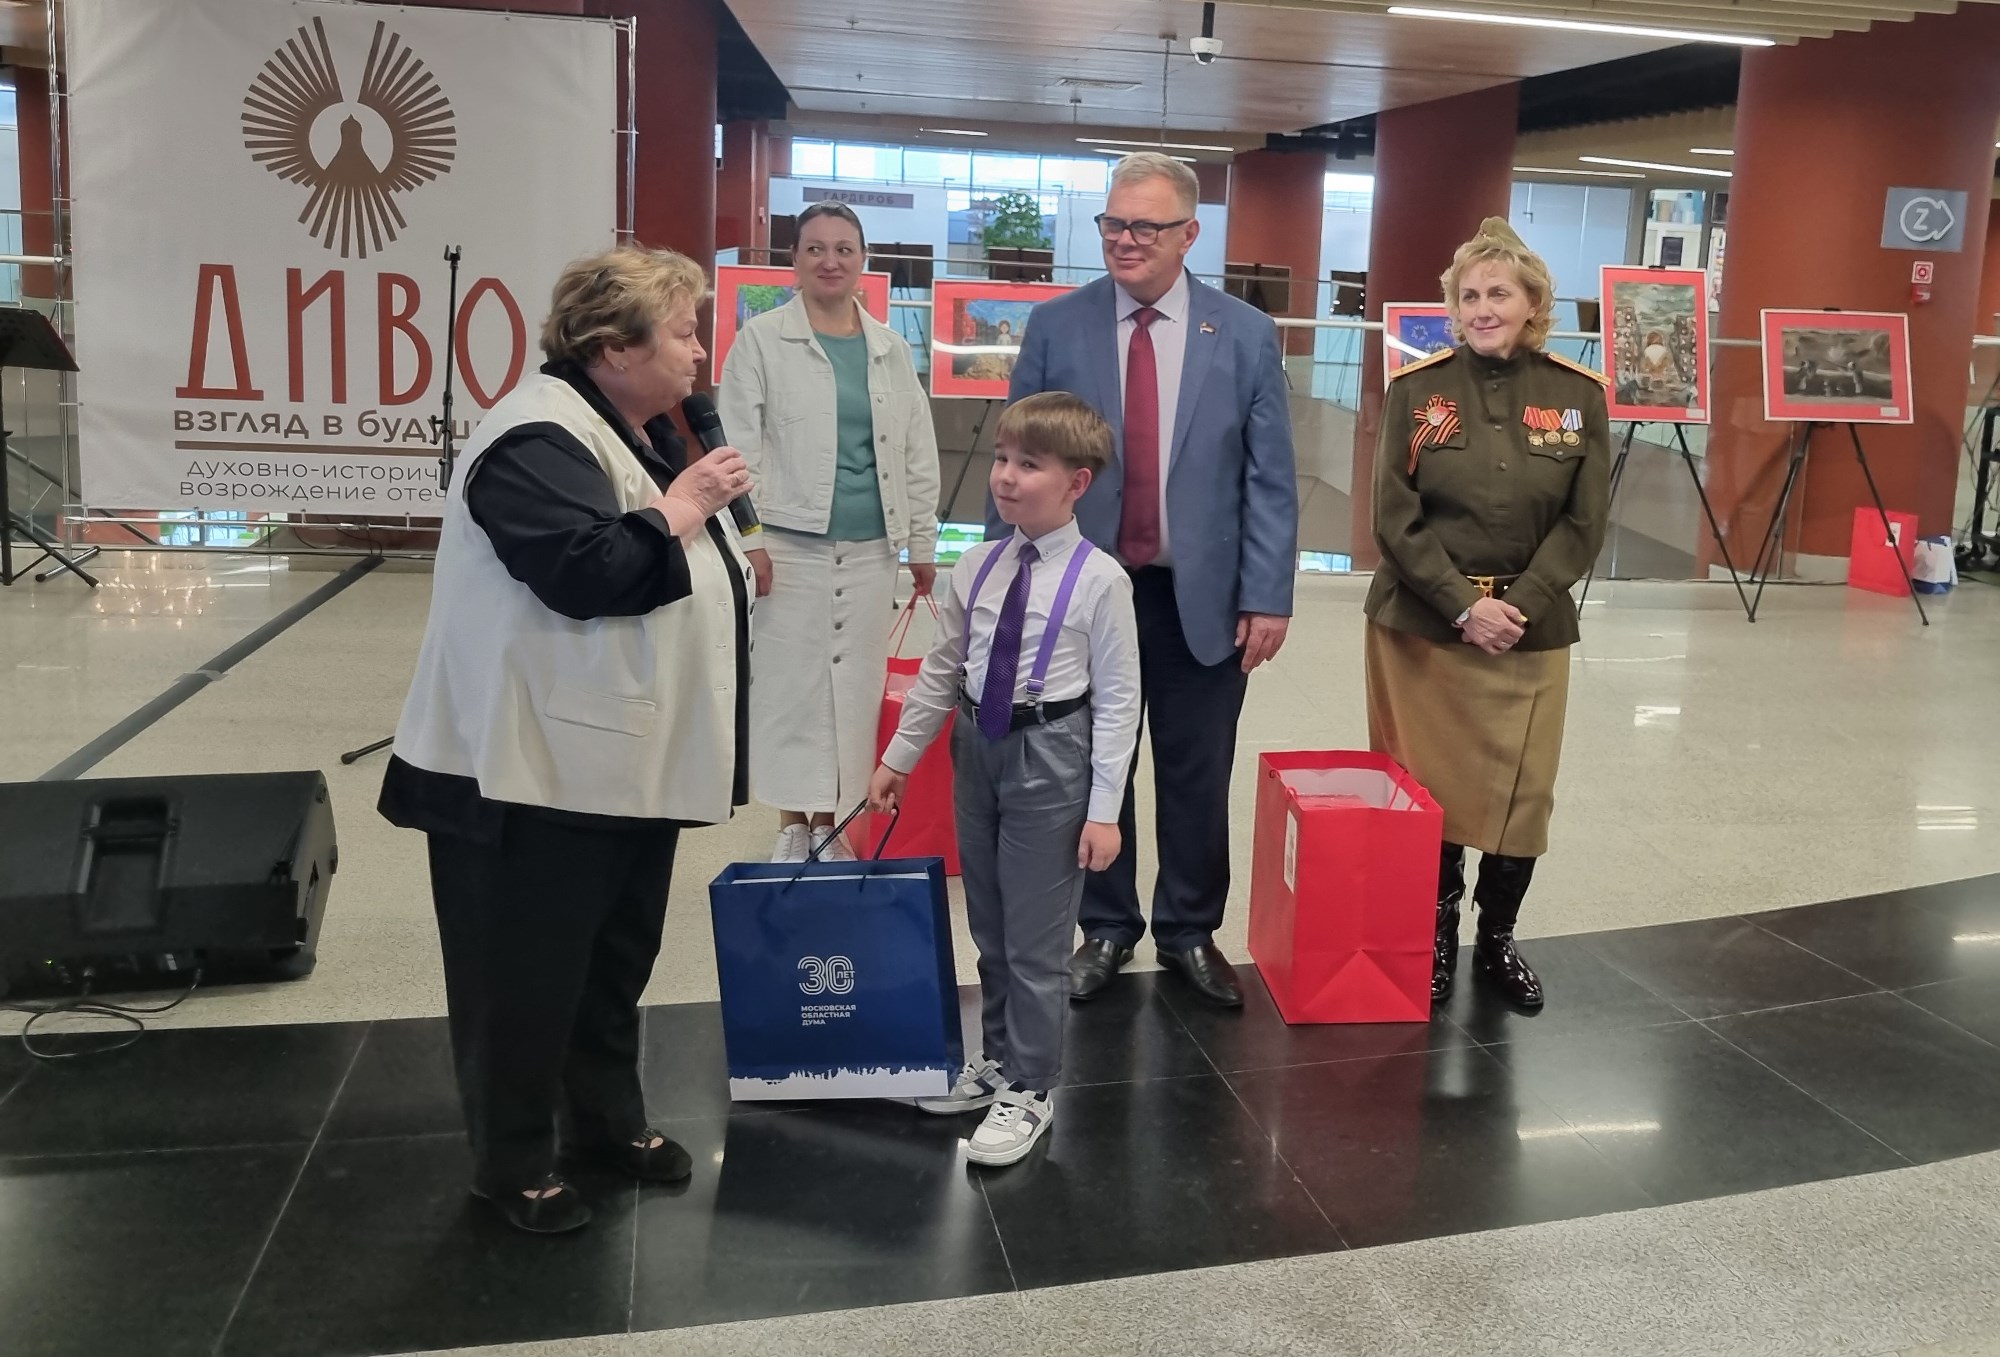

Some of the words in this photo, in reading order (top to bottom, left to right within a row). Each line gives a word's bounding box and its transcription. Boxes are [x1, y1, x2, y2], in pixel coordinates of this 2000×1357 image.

[823, 191, 895, 205] ГАРДЕРОБ
[1913, 207, 1930, 231] Z
[175, 263, 527, 410] ДИВО
[174, 409, 310, 440] взгляд
[323, 415, 344, 436] в
[357, 409, 482, 443] будущ
[187, 460, 438, 484] духовно-историч
[180, 481, 377, 501] возрождение
[387, 486, 447, 502] отеч
[797, 955, 855, 995] 30
[836, 970, 856, 979] ЛЕТ
[801, 1004, 857, 1012] МОСКОВСКАЯ
[801, 1011, 851, 1019] ОБЛАСТНАЯ
